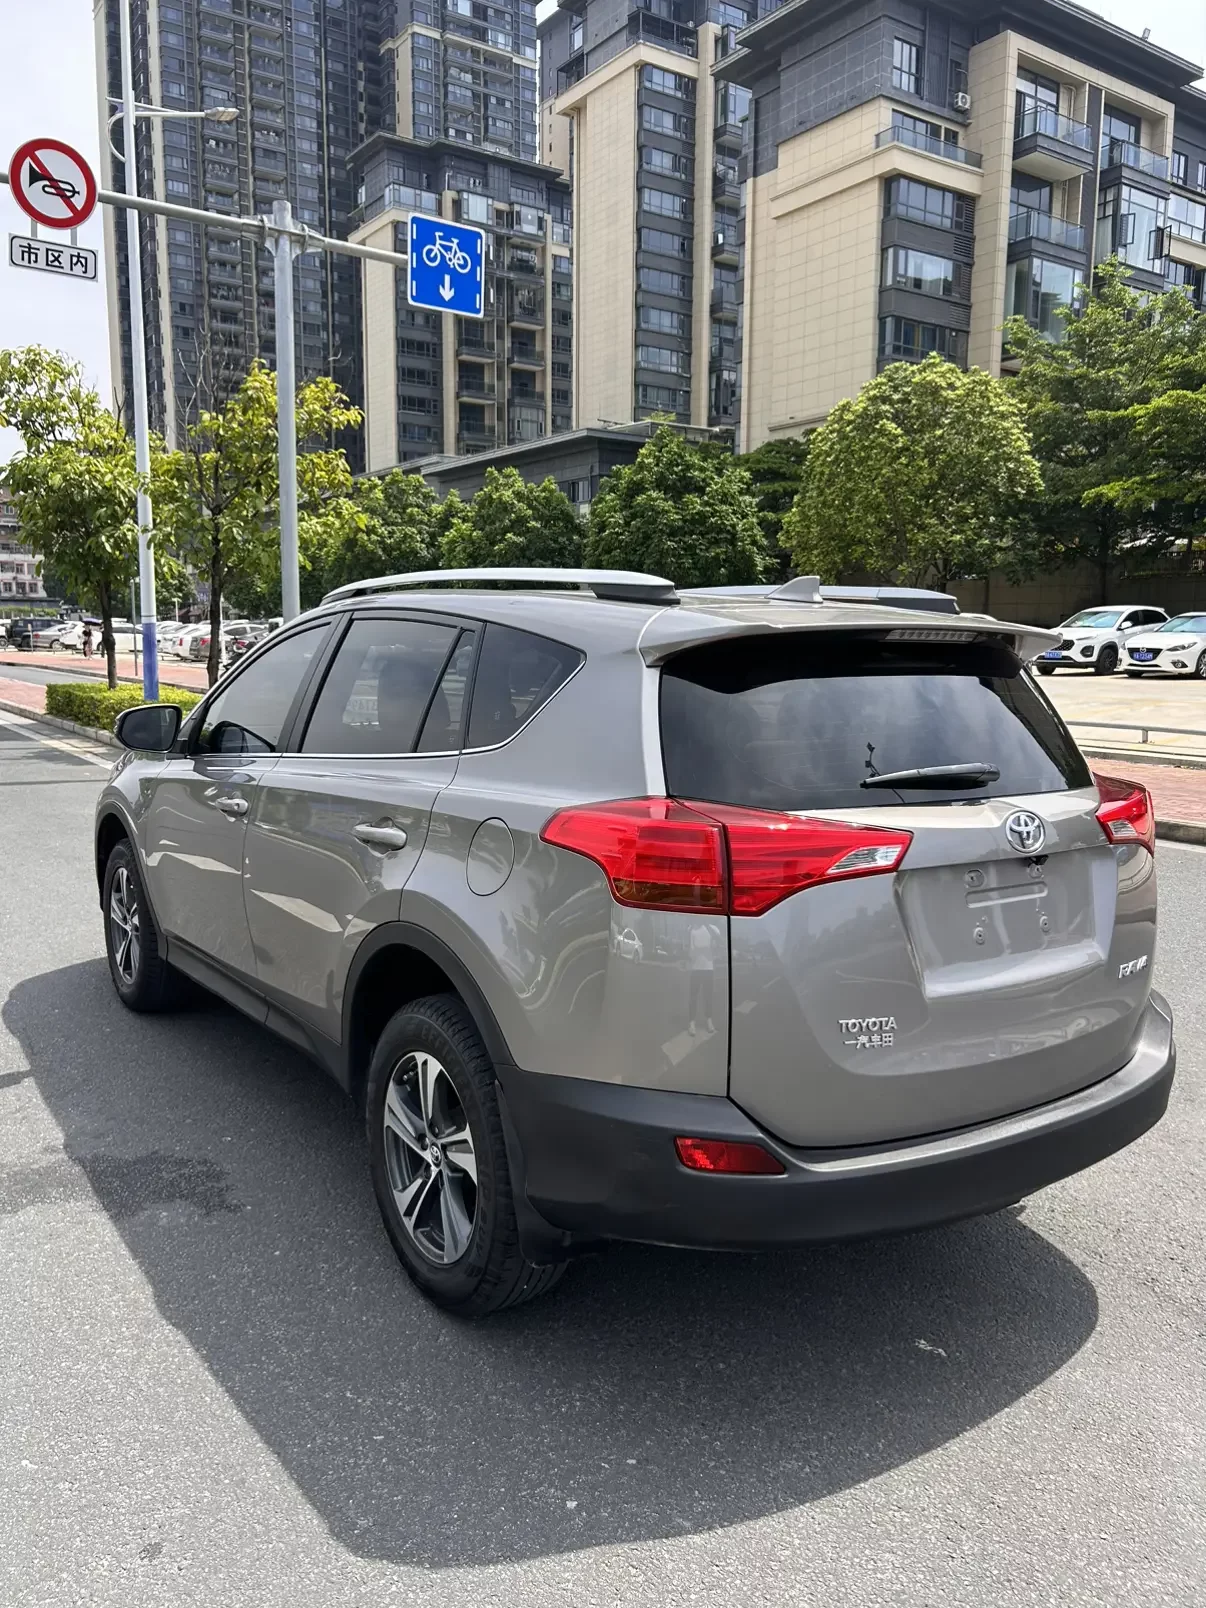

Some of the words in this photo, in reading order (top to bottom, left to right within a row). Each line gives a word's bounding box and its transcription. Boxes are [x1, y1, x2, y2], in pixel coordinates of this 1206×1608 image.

[18, 242, 88, 275] 市区内
[838, 1016, 897, 1033] TOYOTA
